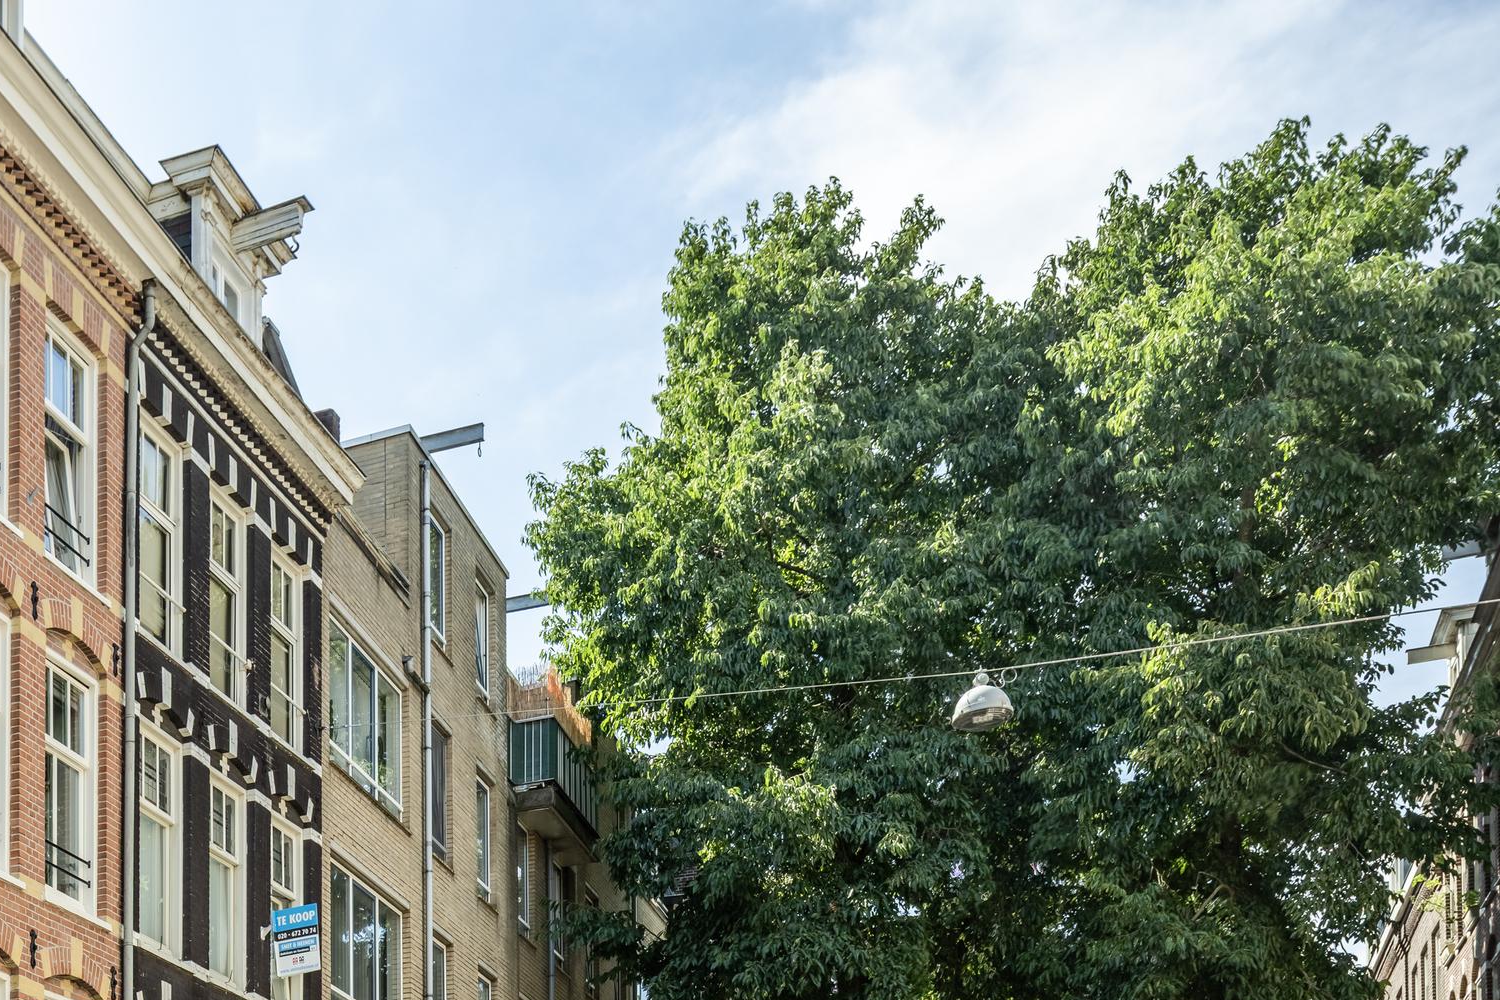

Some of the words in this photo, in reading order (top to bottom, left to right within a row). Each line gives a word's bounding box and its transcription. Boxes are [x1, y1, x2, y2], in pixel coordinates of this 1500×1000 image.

[277, 915, 287, 927] TE
[289, 910, 315, 924] KOOP
[277, 932, 288, 940] 020
